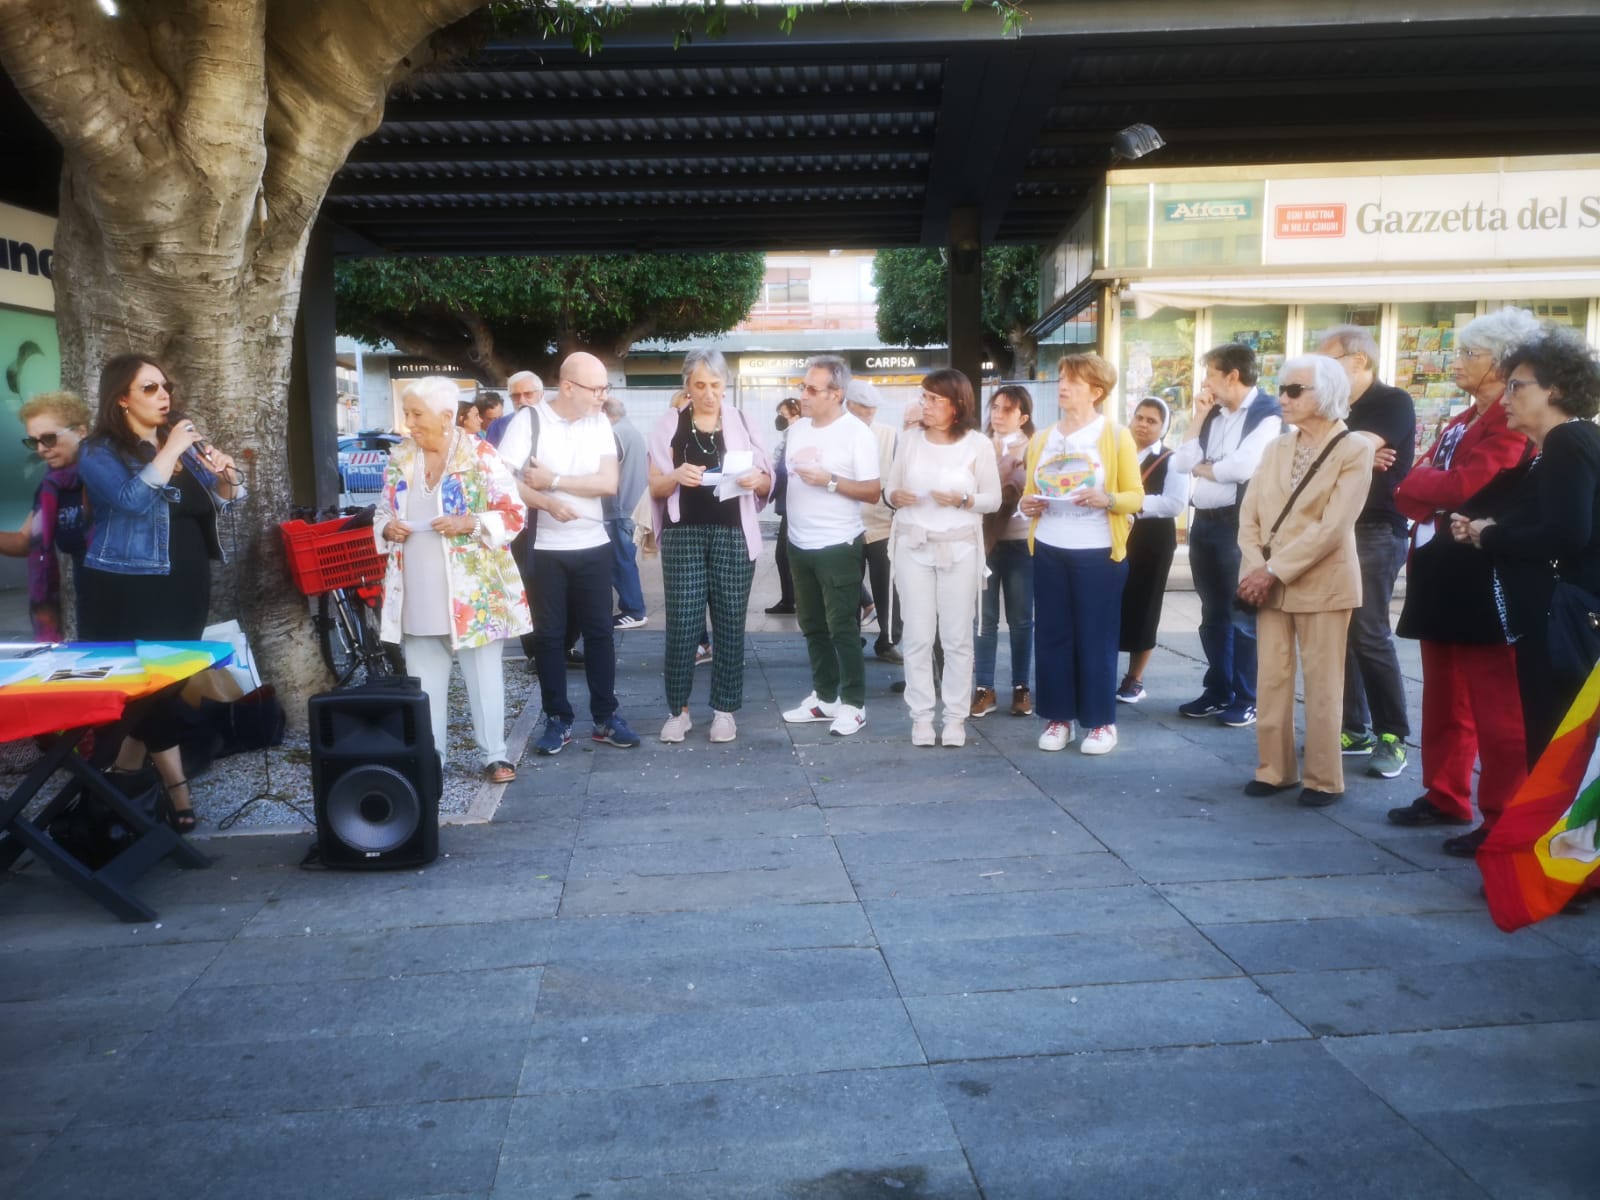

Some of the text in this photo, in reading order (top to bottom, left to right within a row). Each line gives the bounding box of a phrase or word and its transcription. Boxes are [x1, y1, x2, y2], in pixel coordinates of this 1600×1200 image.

[1305, 209, 1335, 220] MATTINA
[1356, 199, 1508, 234] Gazzetta
[1517, 196, 1567, 231] del
[1291, 222, 1310, 232] MILLE
[865, 356, 916, 368] CARPISA
